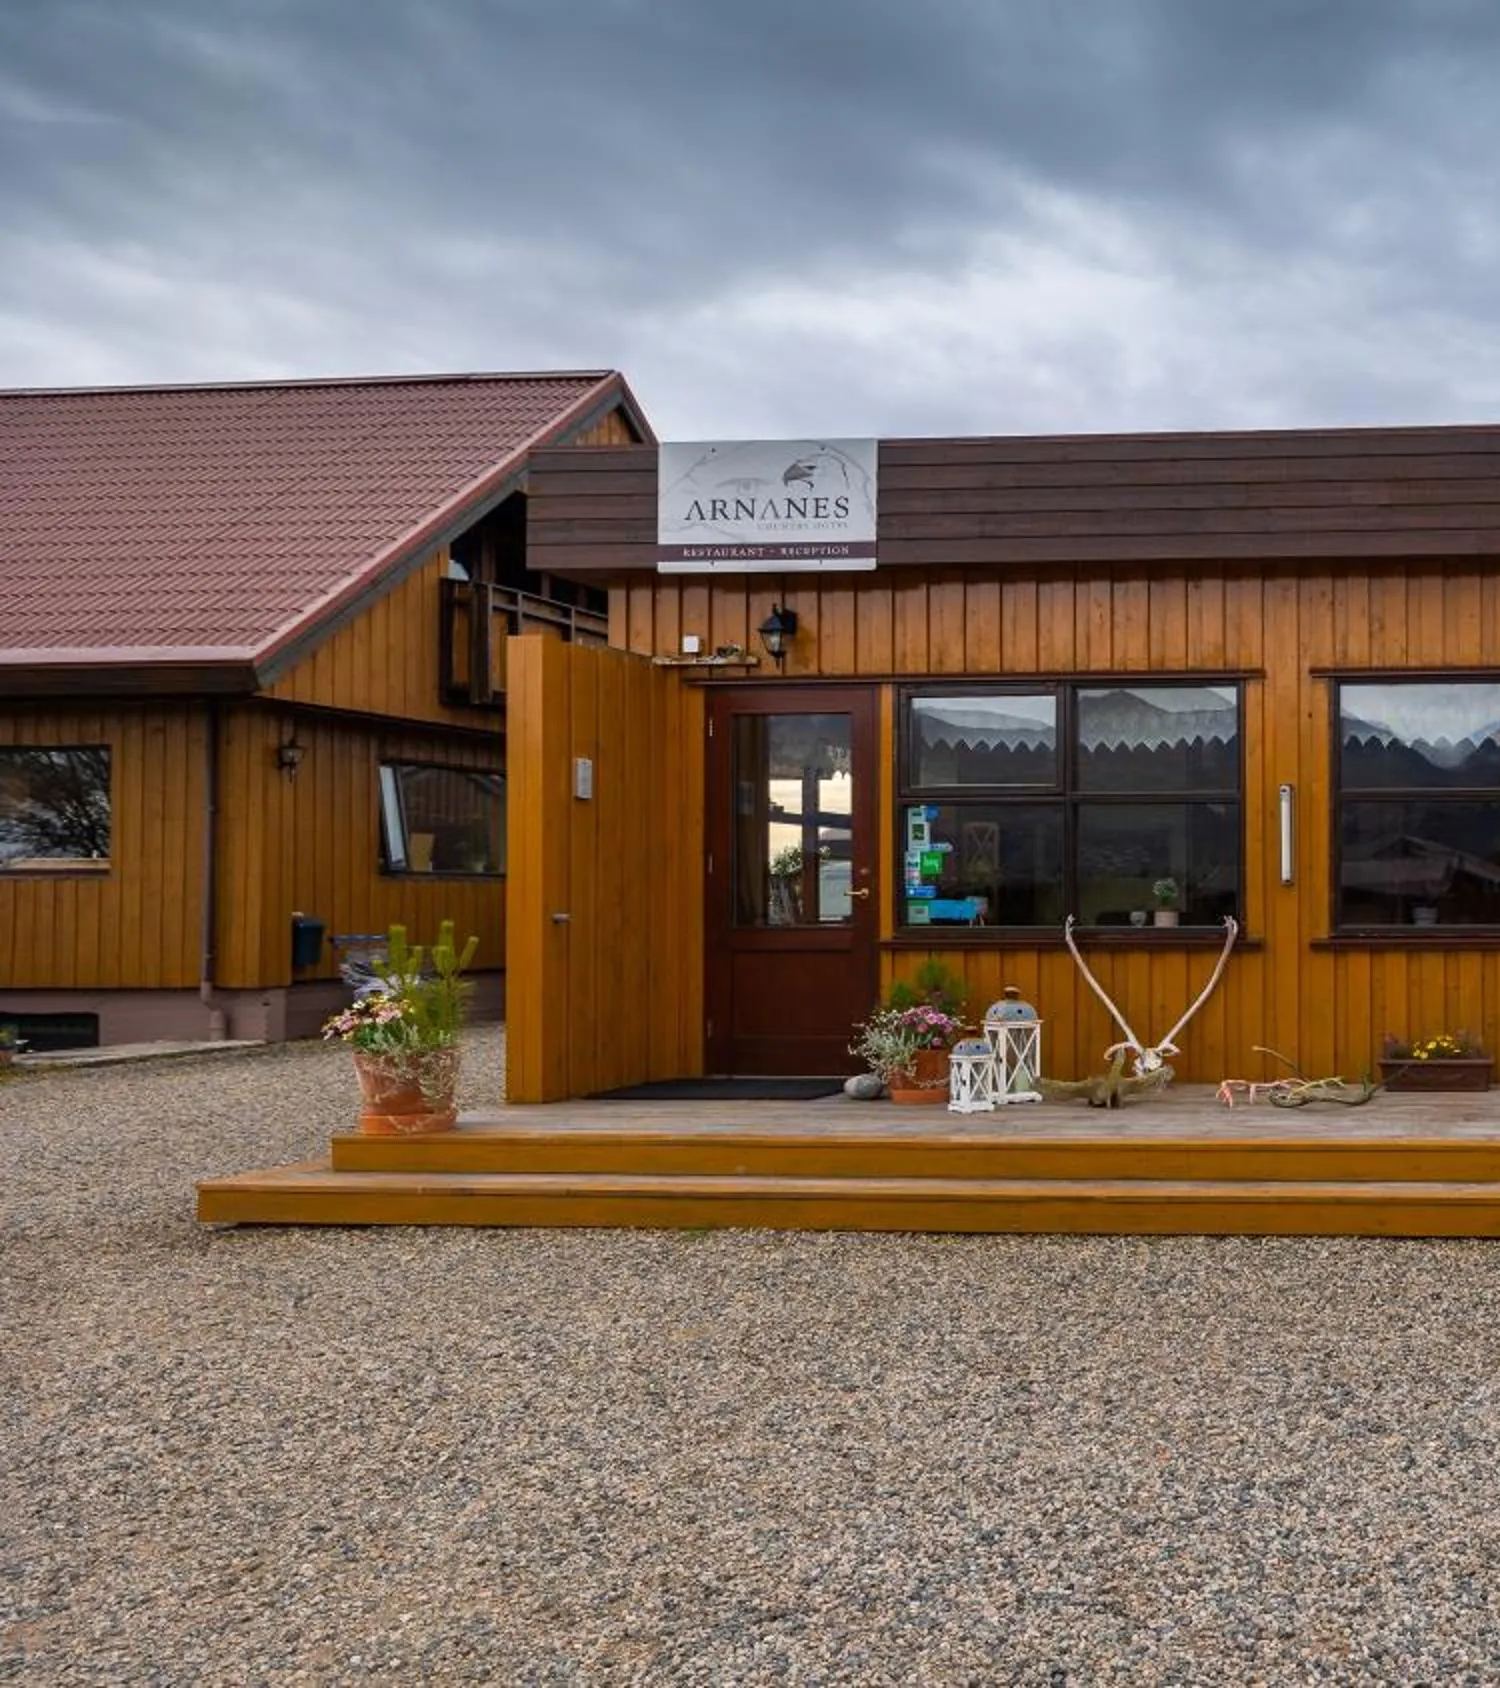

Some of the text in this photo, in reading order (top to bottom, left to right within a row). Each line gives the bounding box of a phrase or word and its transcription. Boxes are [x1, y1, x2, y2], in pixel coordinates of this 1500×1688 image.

[684, 496, 849, 521] ARNANES
[683, 545, 849, 557] RESTAURANT RECEPTION
